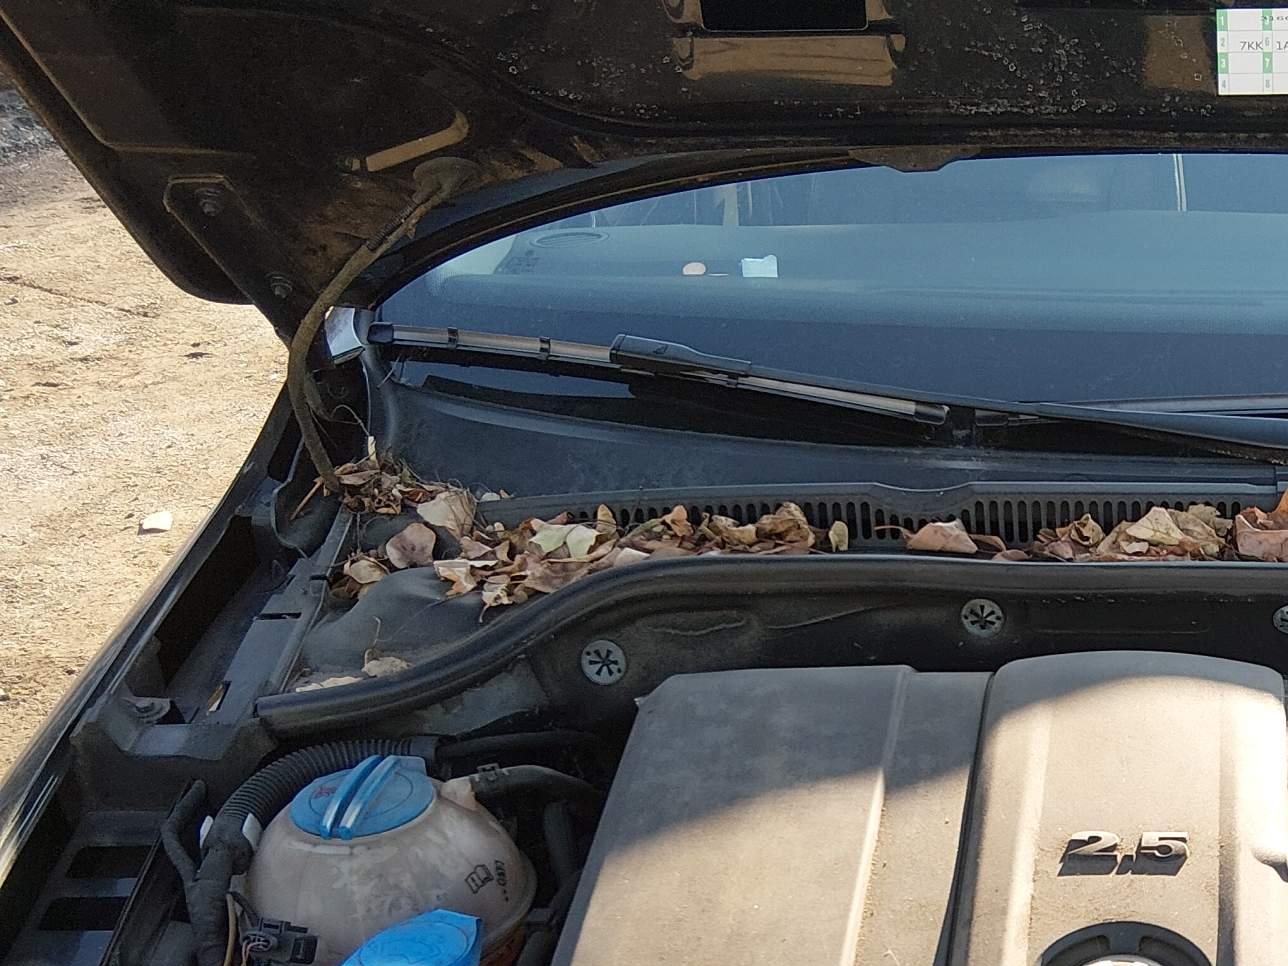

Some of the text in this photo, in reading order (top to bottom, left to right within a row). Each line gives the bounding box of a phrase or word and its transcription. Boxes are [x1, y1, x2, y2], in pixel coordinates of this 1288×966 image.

[1240, 41, 1263, 51] 7KK
[1264, 58, 1270, 68] 7
[1058, 830, 1190, 877] 2.5
